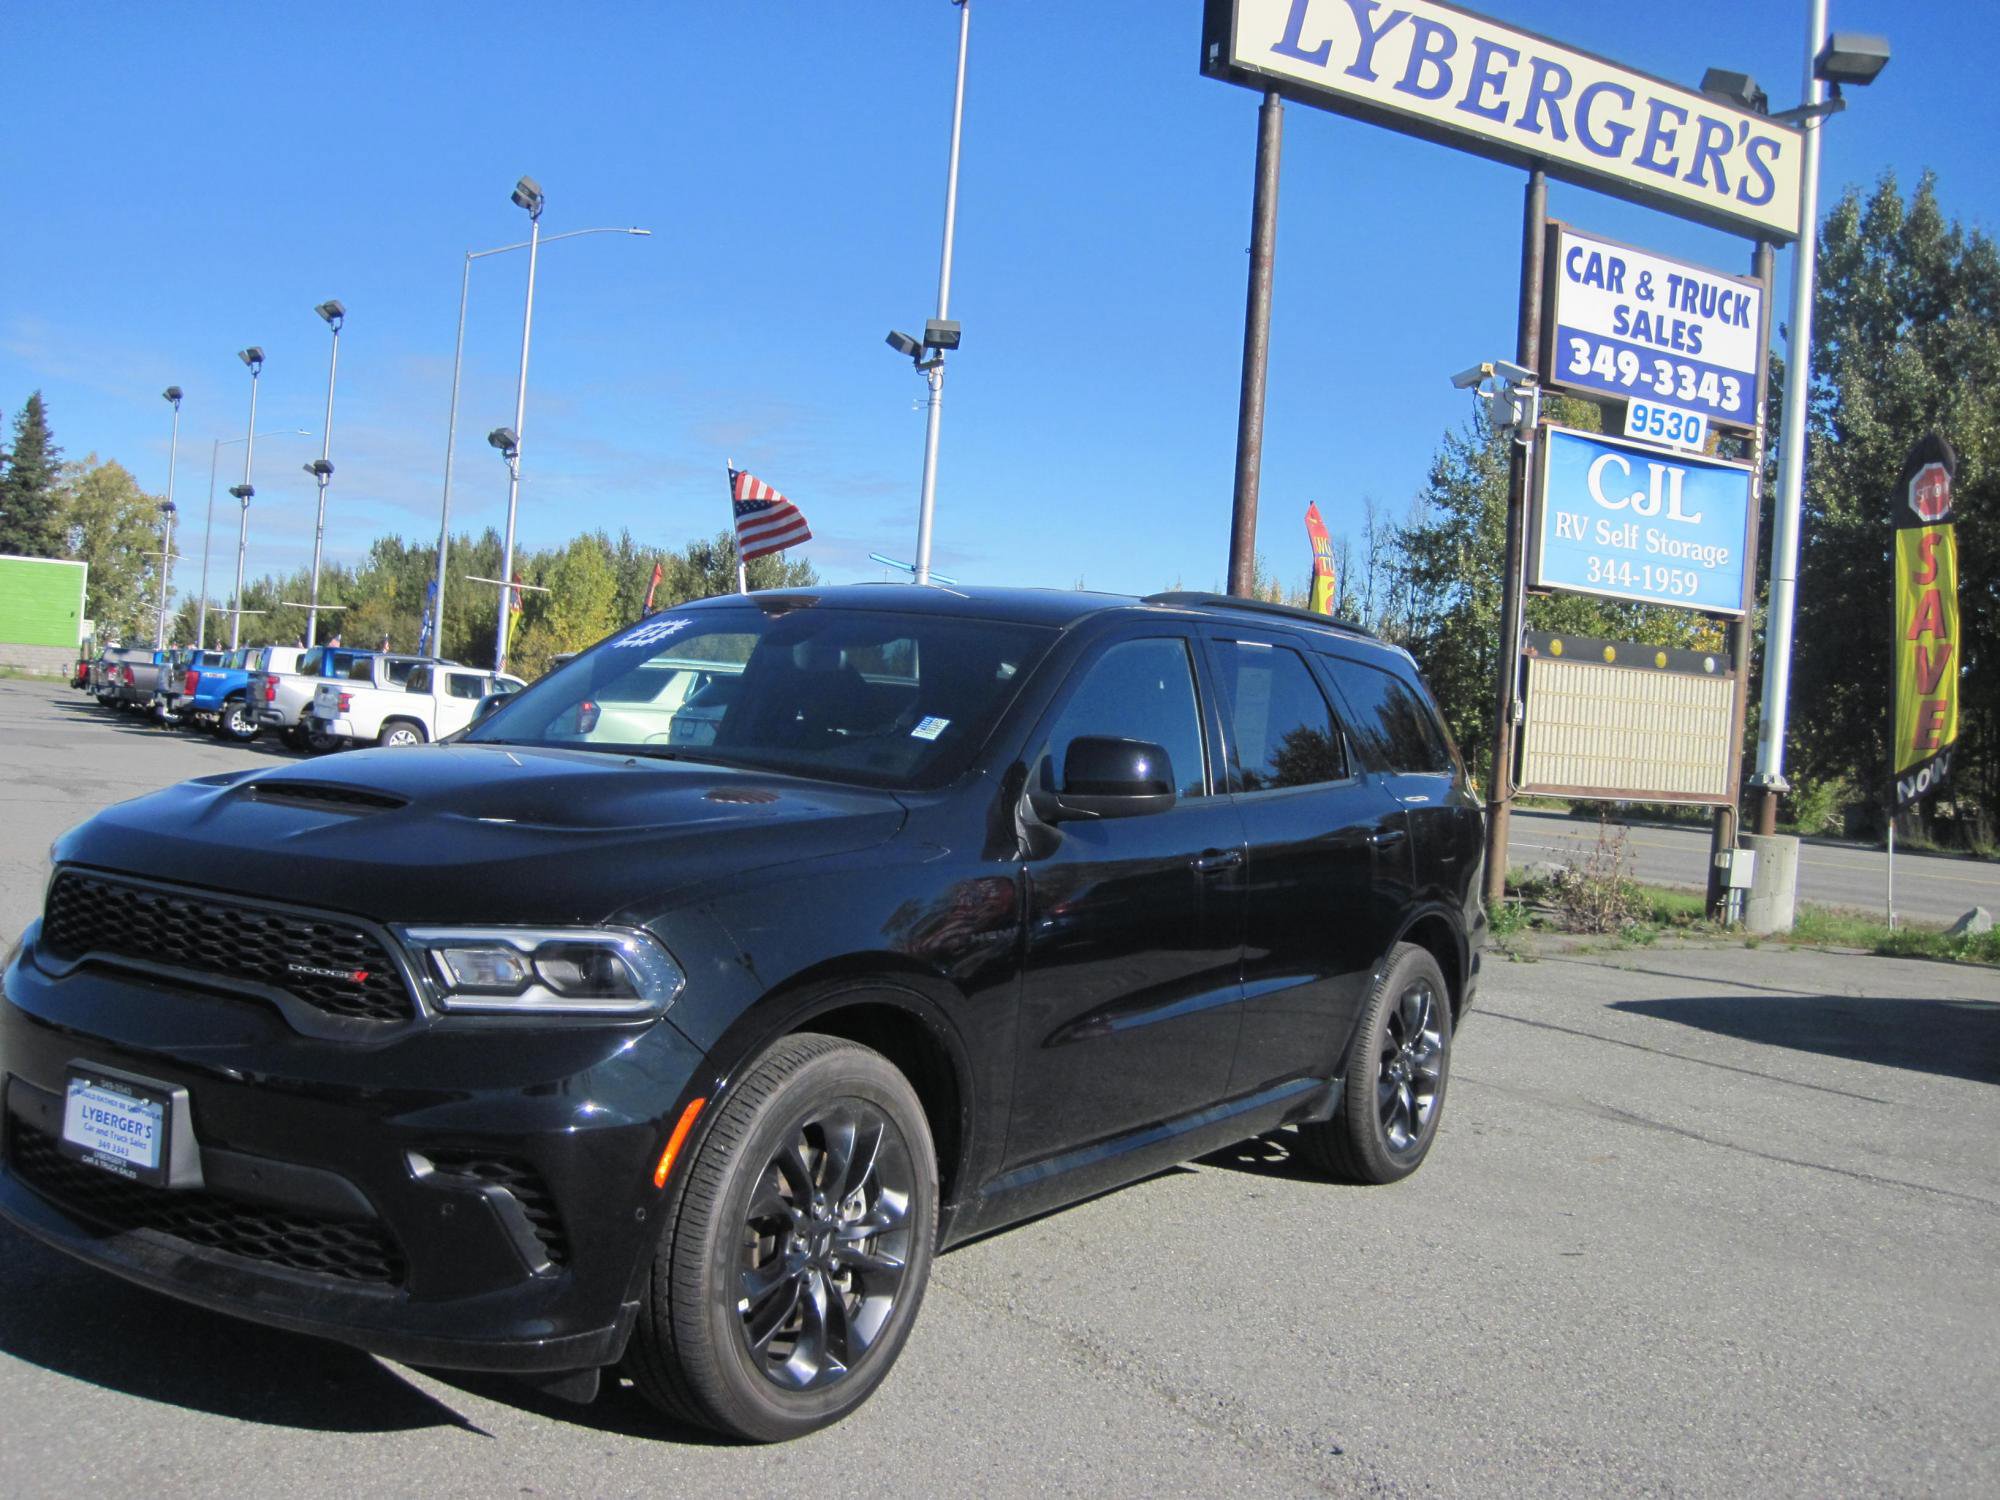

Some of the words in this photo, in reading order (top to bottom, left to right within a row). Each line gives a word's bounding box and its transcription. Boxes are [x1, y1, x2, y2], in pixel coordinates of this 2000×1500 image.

[1271, 0, 1782, 206] LYBERGER'S
[1566, 246, 1626, 294] CAR
[1635, 271, 1655, 302] &
[1667, 273, 1751, 328] TRUCK
[1613, 304, 1702, 355] SALES
[1568, 337, 1741, 412] 349-3343
[1631, 404, 1700, 444] 9530
[1587, 453, 1701, 524] CJL
[1555, 511, 1589, 541] RV
[1595, 519, 1640, 550] Self
[1645, 528, 1729, 568] Storage
[1587, 556, 1698, 596] 344-1959
[1907, 532, 1953, 750] SAVE
[1896, 751, 1953, 803] NOW
[82, 1105, 152, 1139] LYBERGER'S
[110, 1129, 128, 1144] Truck
